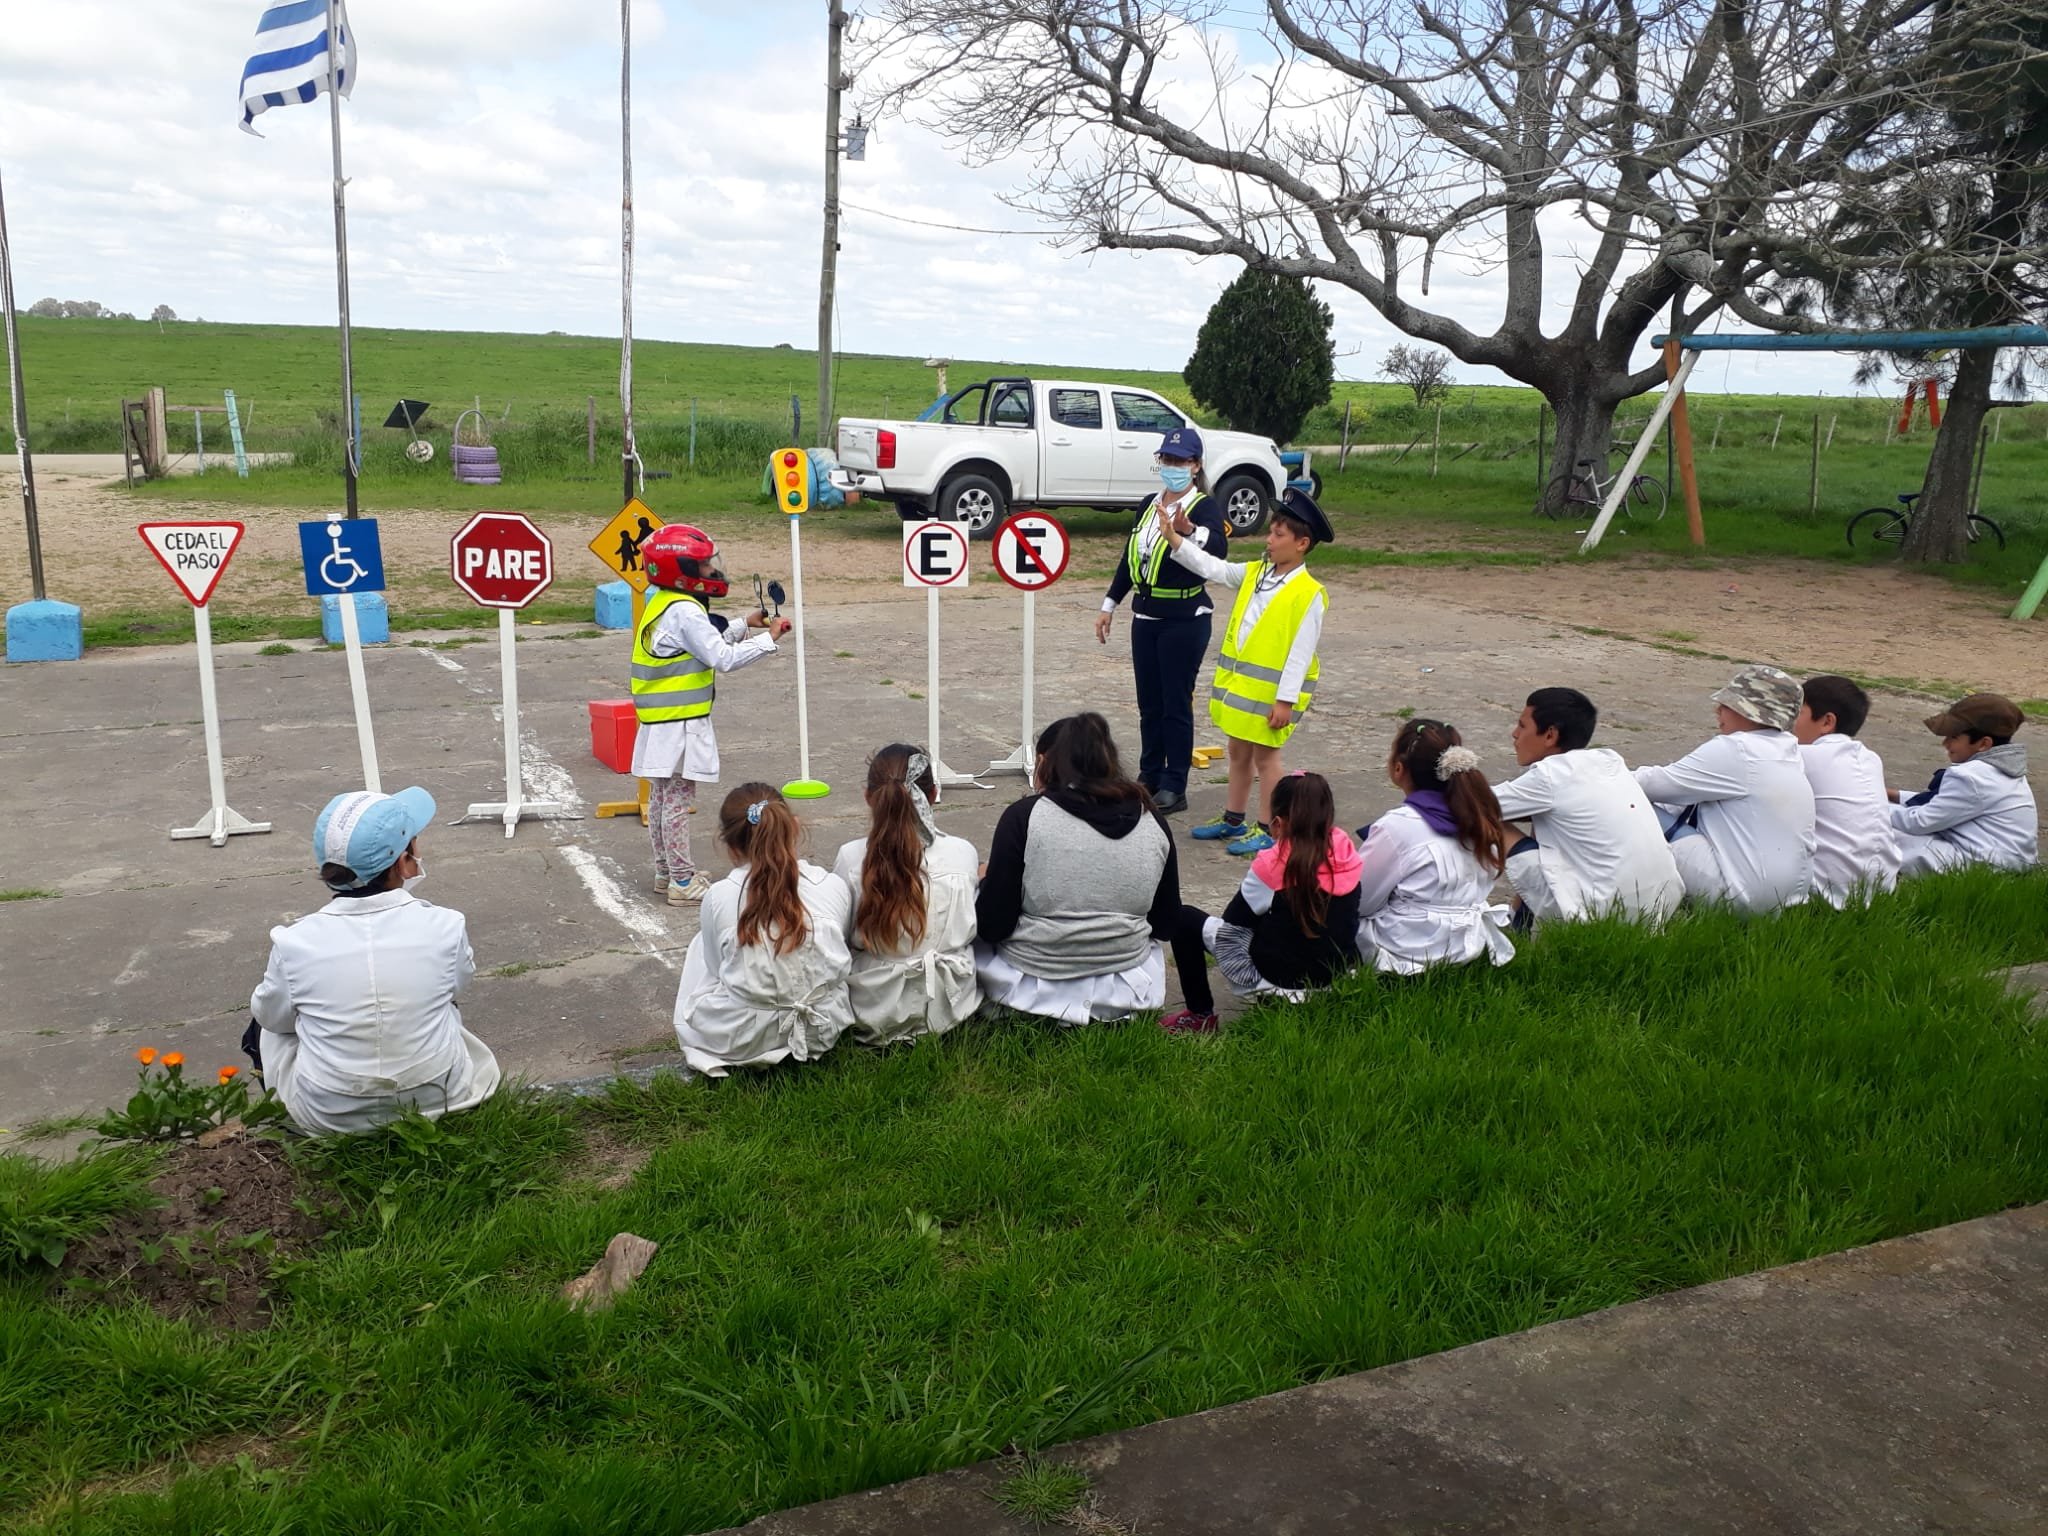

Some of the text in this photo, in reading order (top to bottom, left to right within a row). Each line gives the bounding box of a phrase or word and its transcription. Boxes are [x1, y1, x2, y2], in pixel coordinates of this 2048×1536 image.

[165, 532, 228, 550] CEDA EL
[920, 532, 952, 576] E
[1016, 528, 1046, 573] E
[176, 552, 220, 569] PASO
[465, 547, 541, 580] PARE
